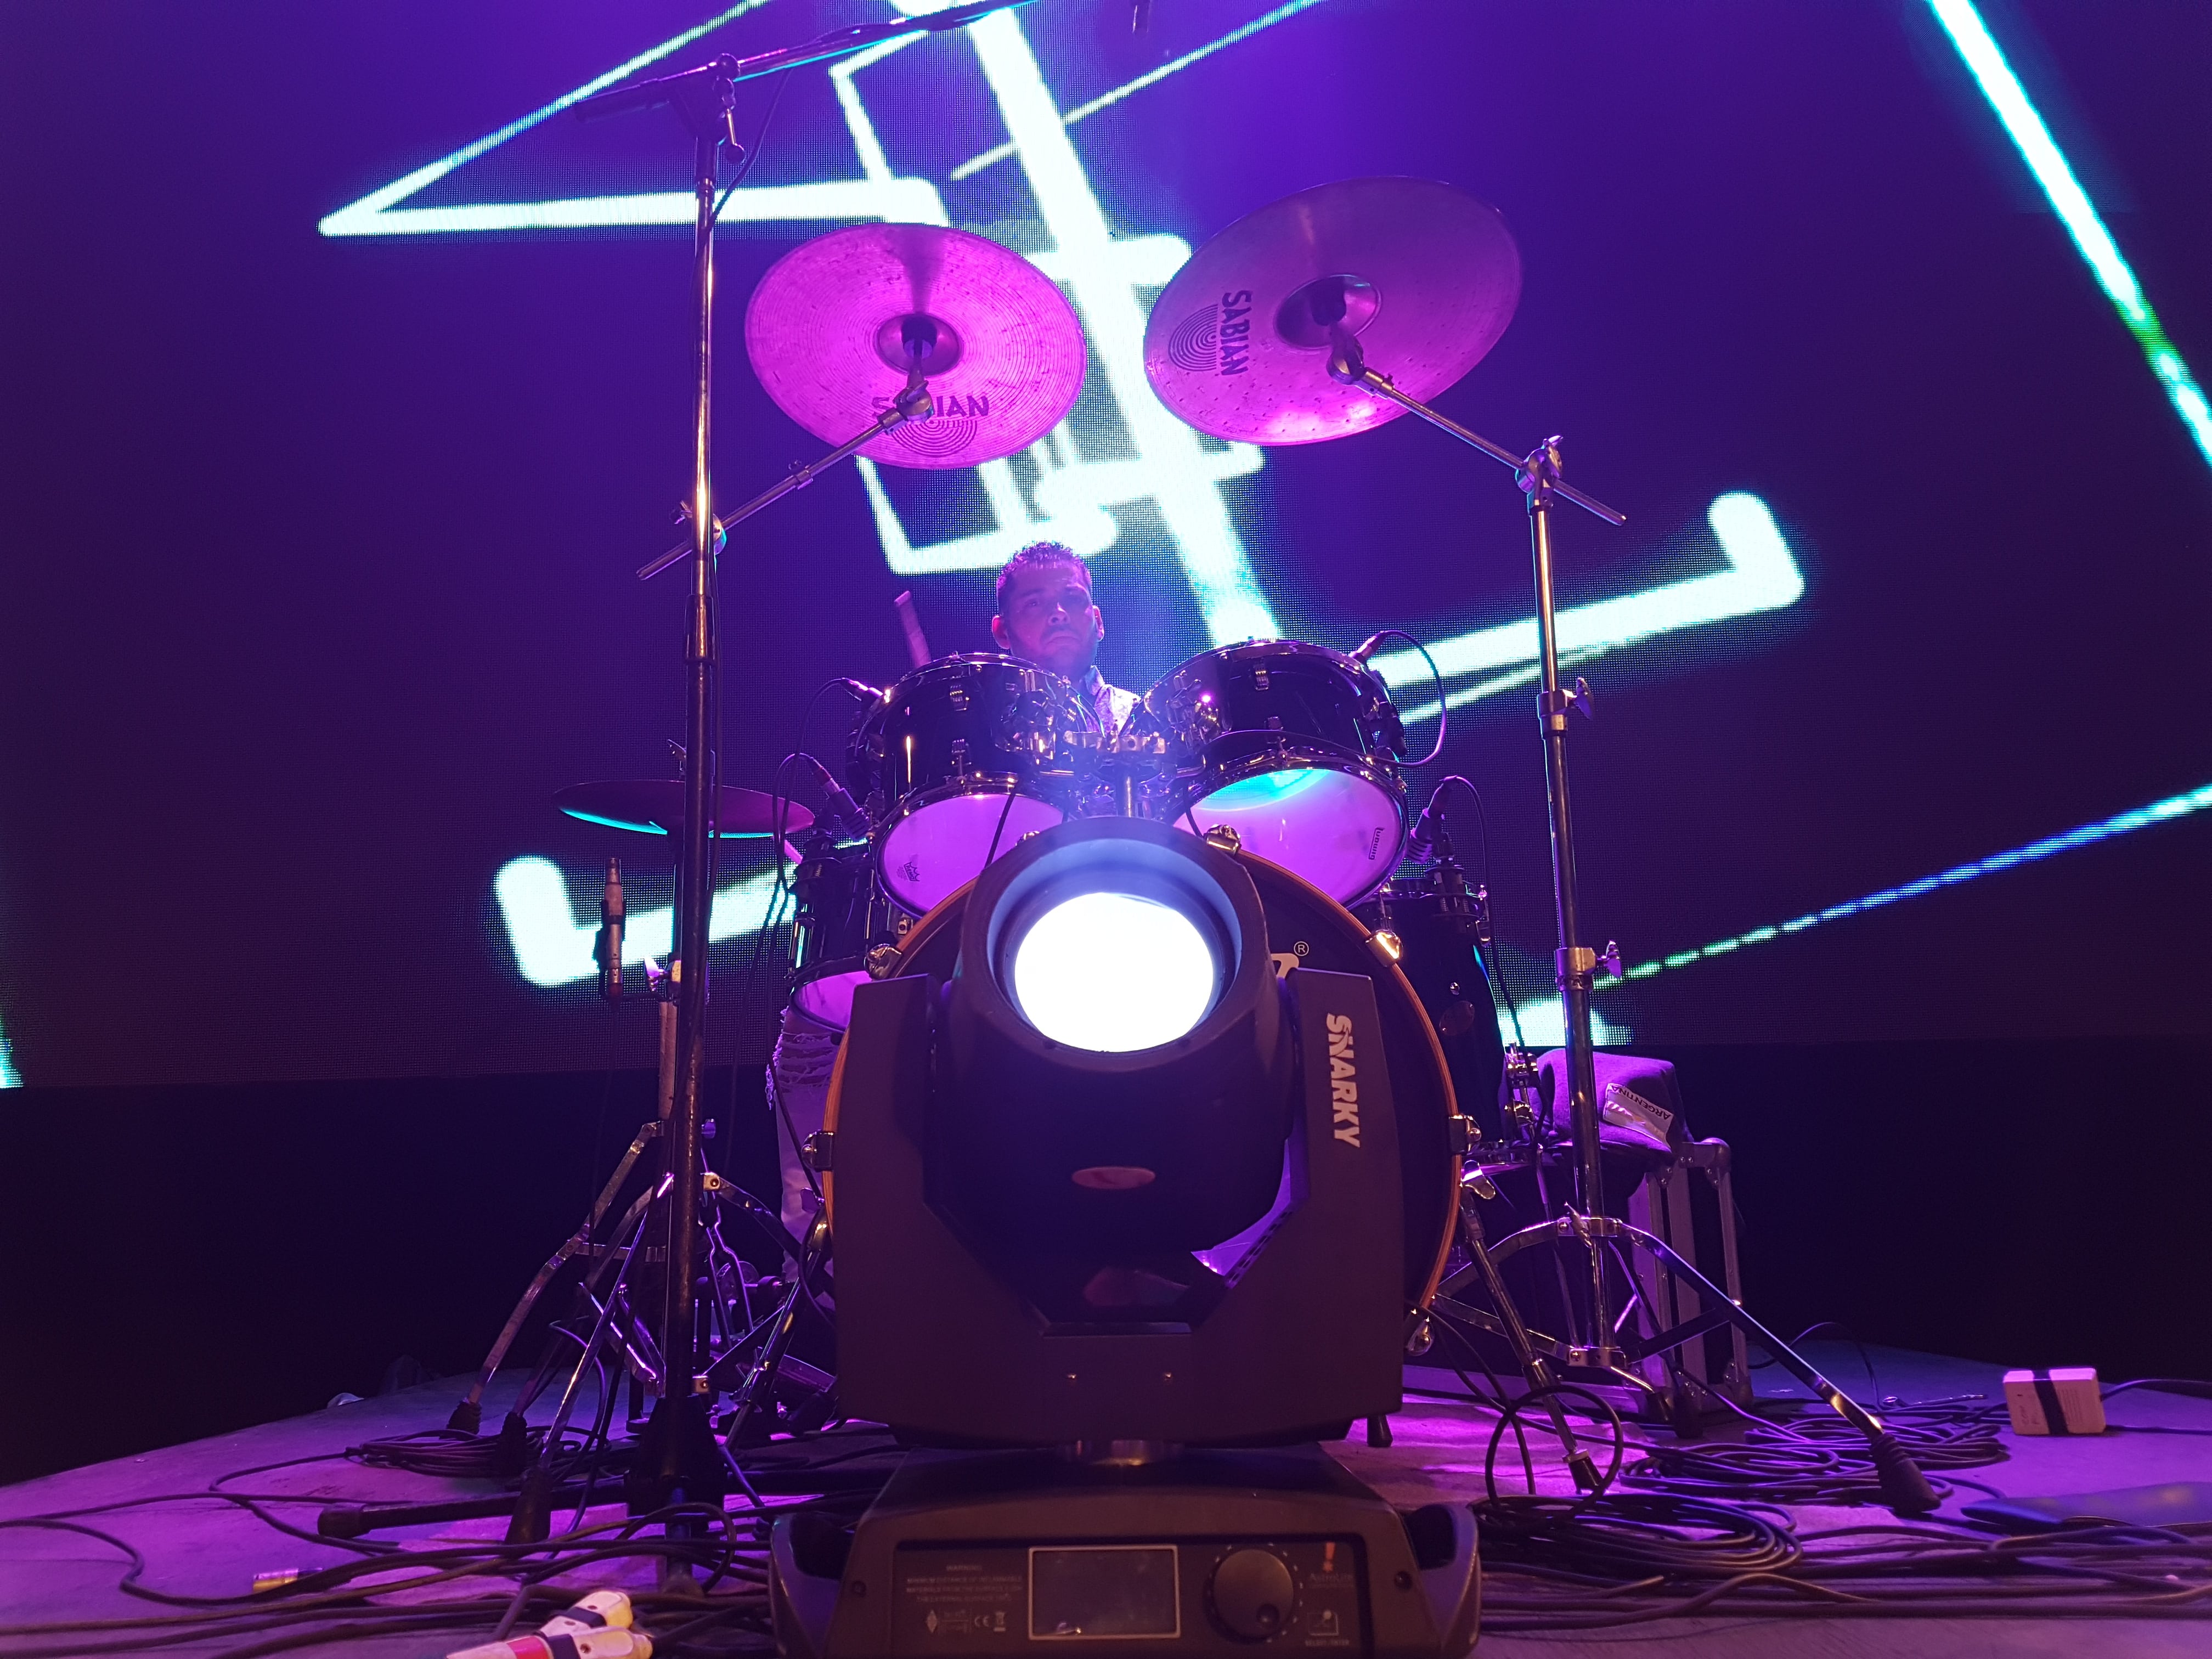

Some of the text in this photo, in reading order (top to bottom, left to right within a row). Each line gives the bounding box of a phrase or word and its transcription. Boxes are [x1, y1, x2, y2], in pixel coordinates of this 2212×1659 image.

[1220, 290, 1253, 375] SABIAN
[871, 394, 990, 417] SIAN
[1325, 1012, 1361, 1148] SNARKY
[1611, 1085, 1672, 1120] ARGENTINA
